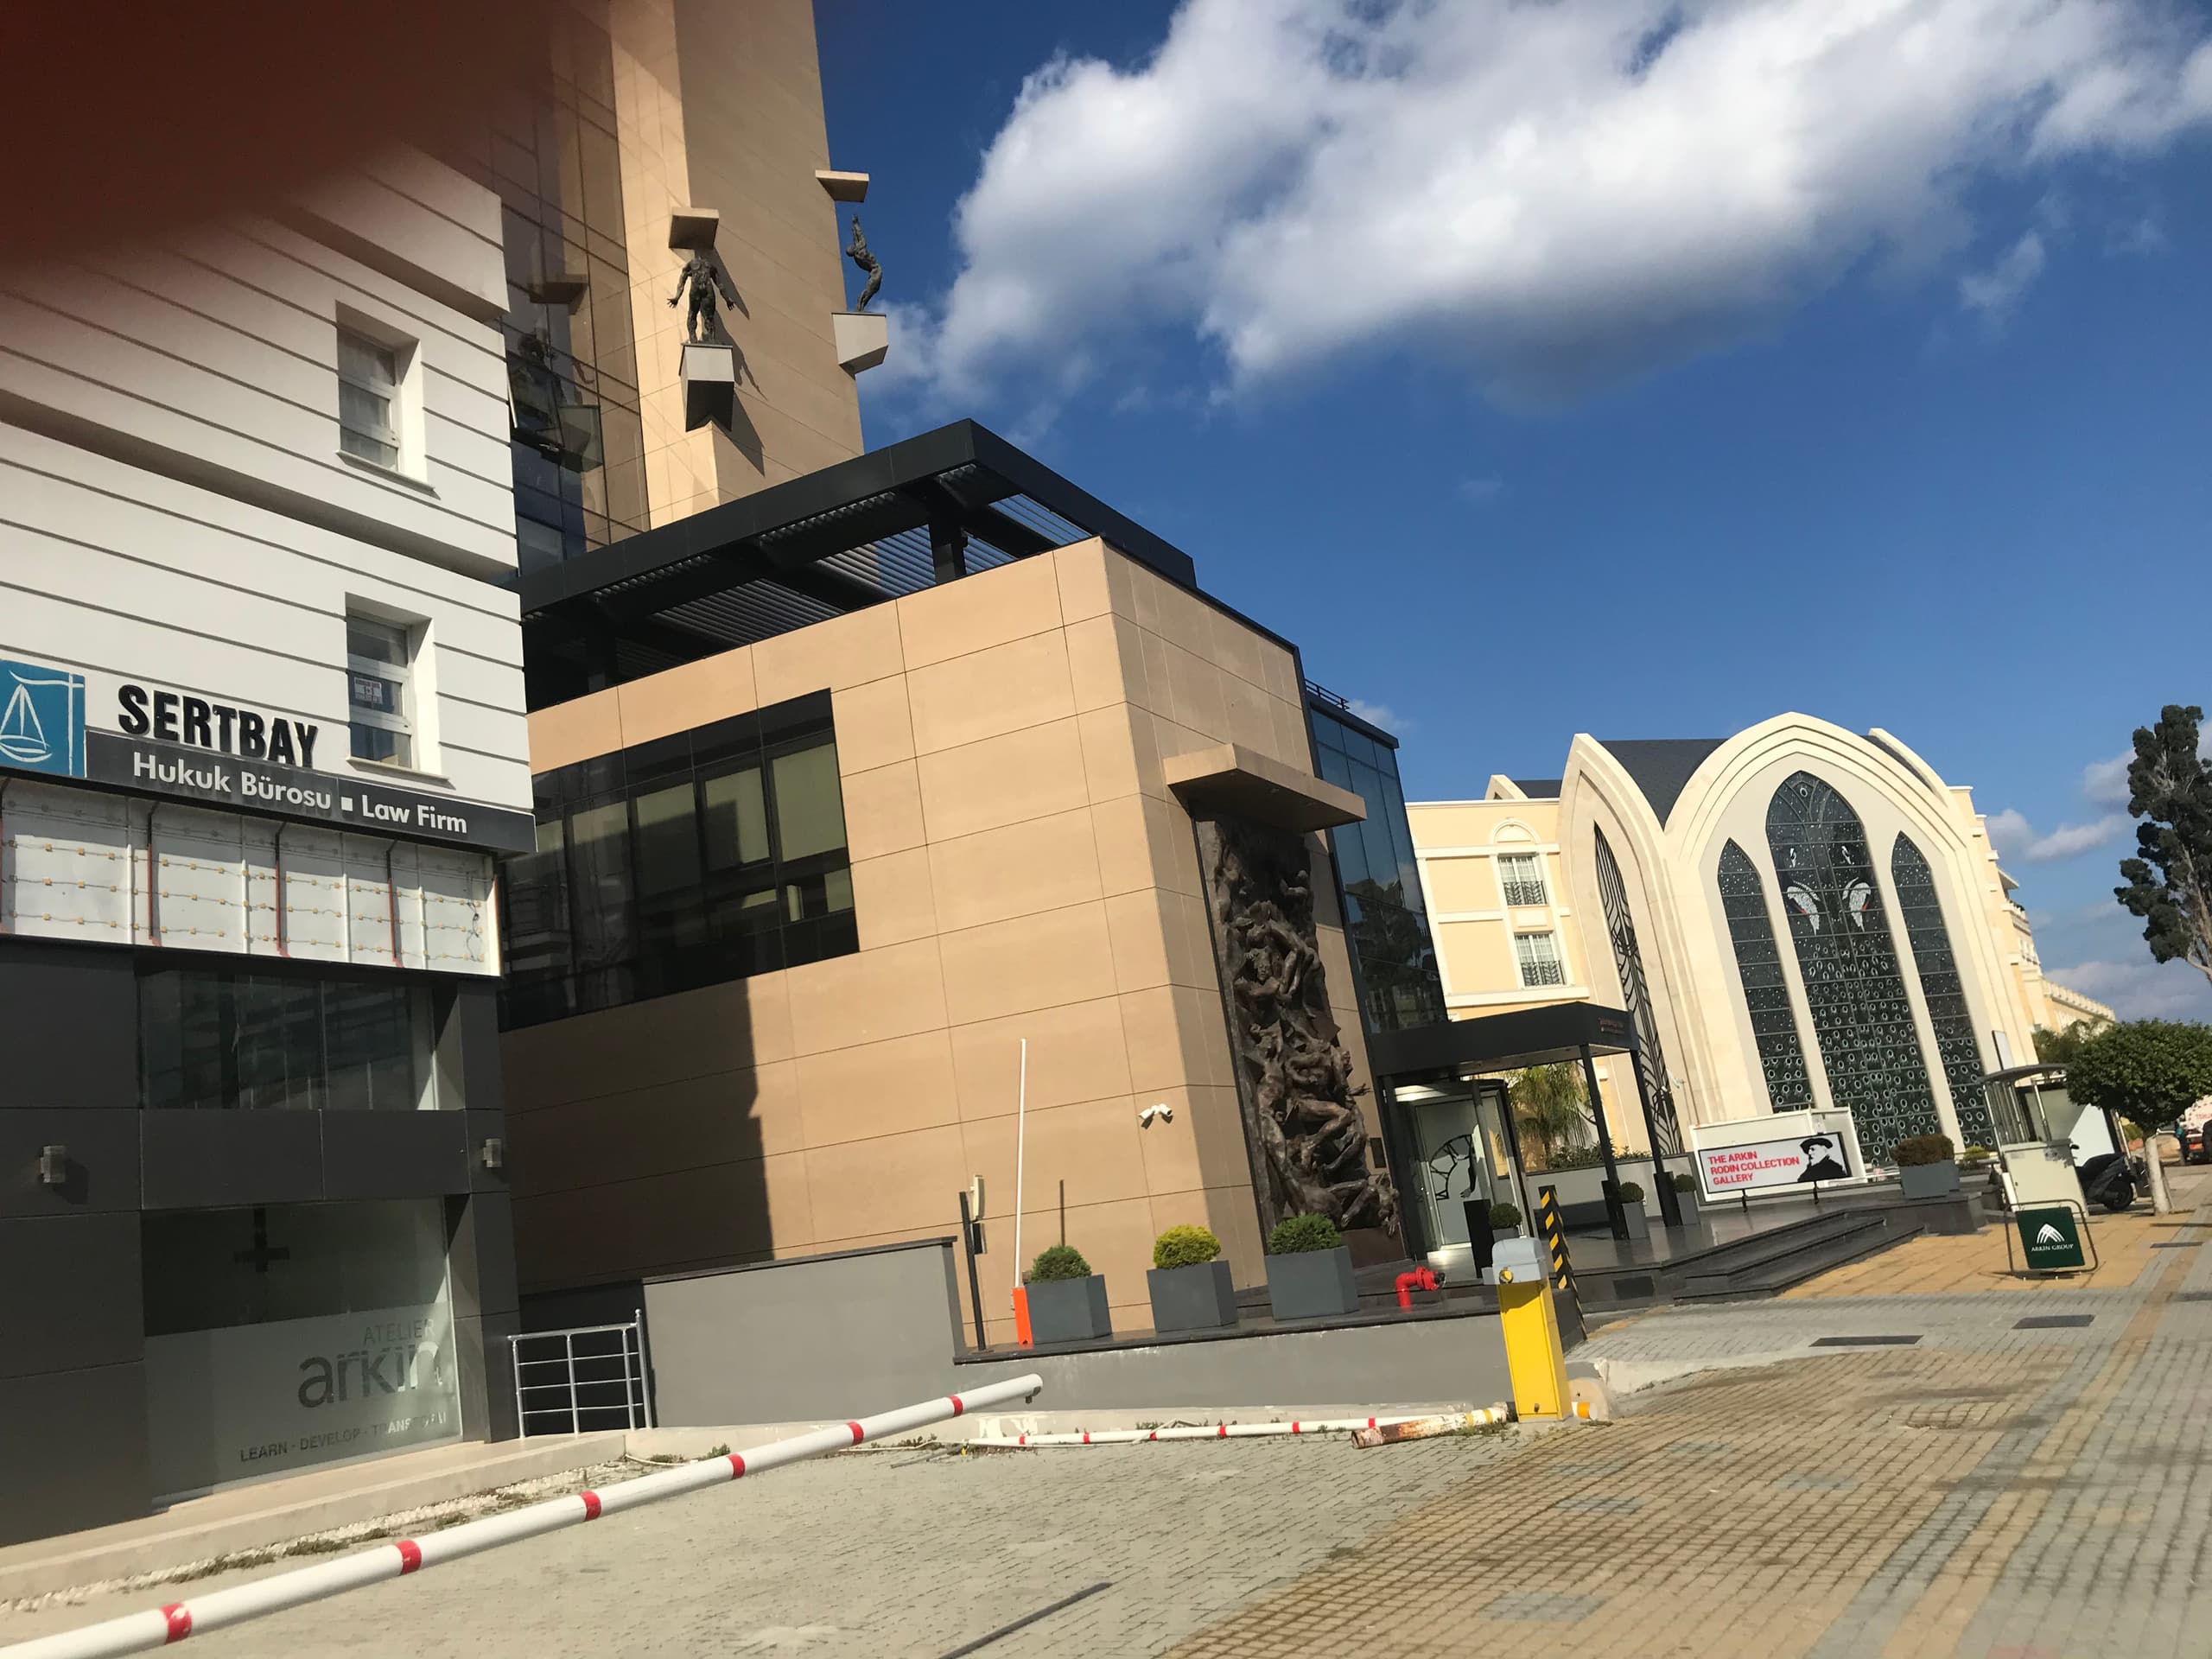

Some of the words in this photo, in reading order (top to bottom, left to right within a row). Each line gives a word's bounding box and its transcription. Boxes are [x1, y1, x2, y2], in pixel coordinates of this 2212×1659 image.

[118, 683, 319, 768] SERTBAY
[133, 752, 232, 793] Hukuk
[240, 772, 332, 810] Bürosu
[362, 795, 410, 824] Law
[416, 804, 467, 834] Firm
[1708, 1154, 1726, 1165] THE
[1728, 1151, 1758, 1163] ARKIN
[1710, 1165, 1740, 1176] RODIN
[1741, 1156, 1800, 1172] COLLECTION
[1713, 1173, 1753, 1185] GALLERY
[364, 1319, 435, 1345] ATELIER
[239, 1440, 289, 1463] LEARN
[300, 1425, 361, 1452] DEVELOP
